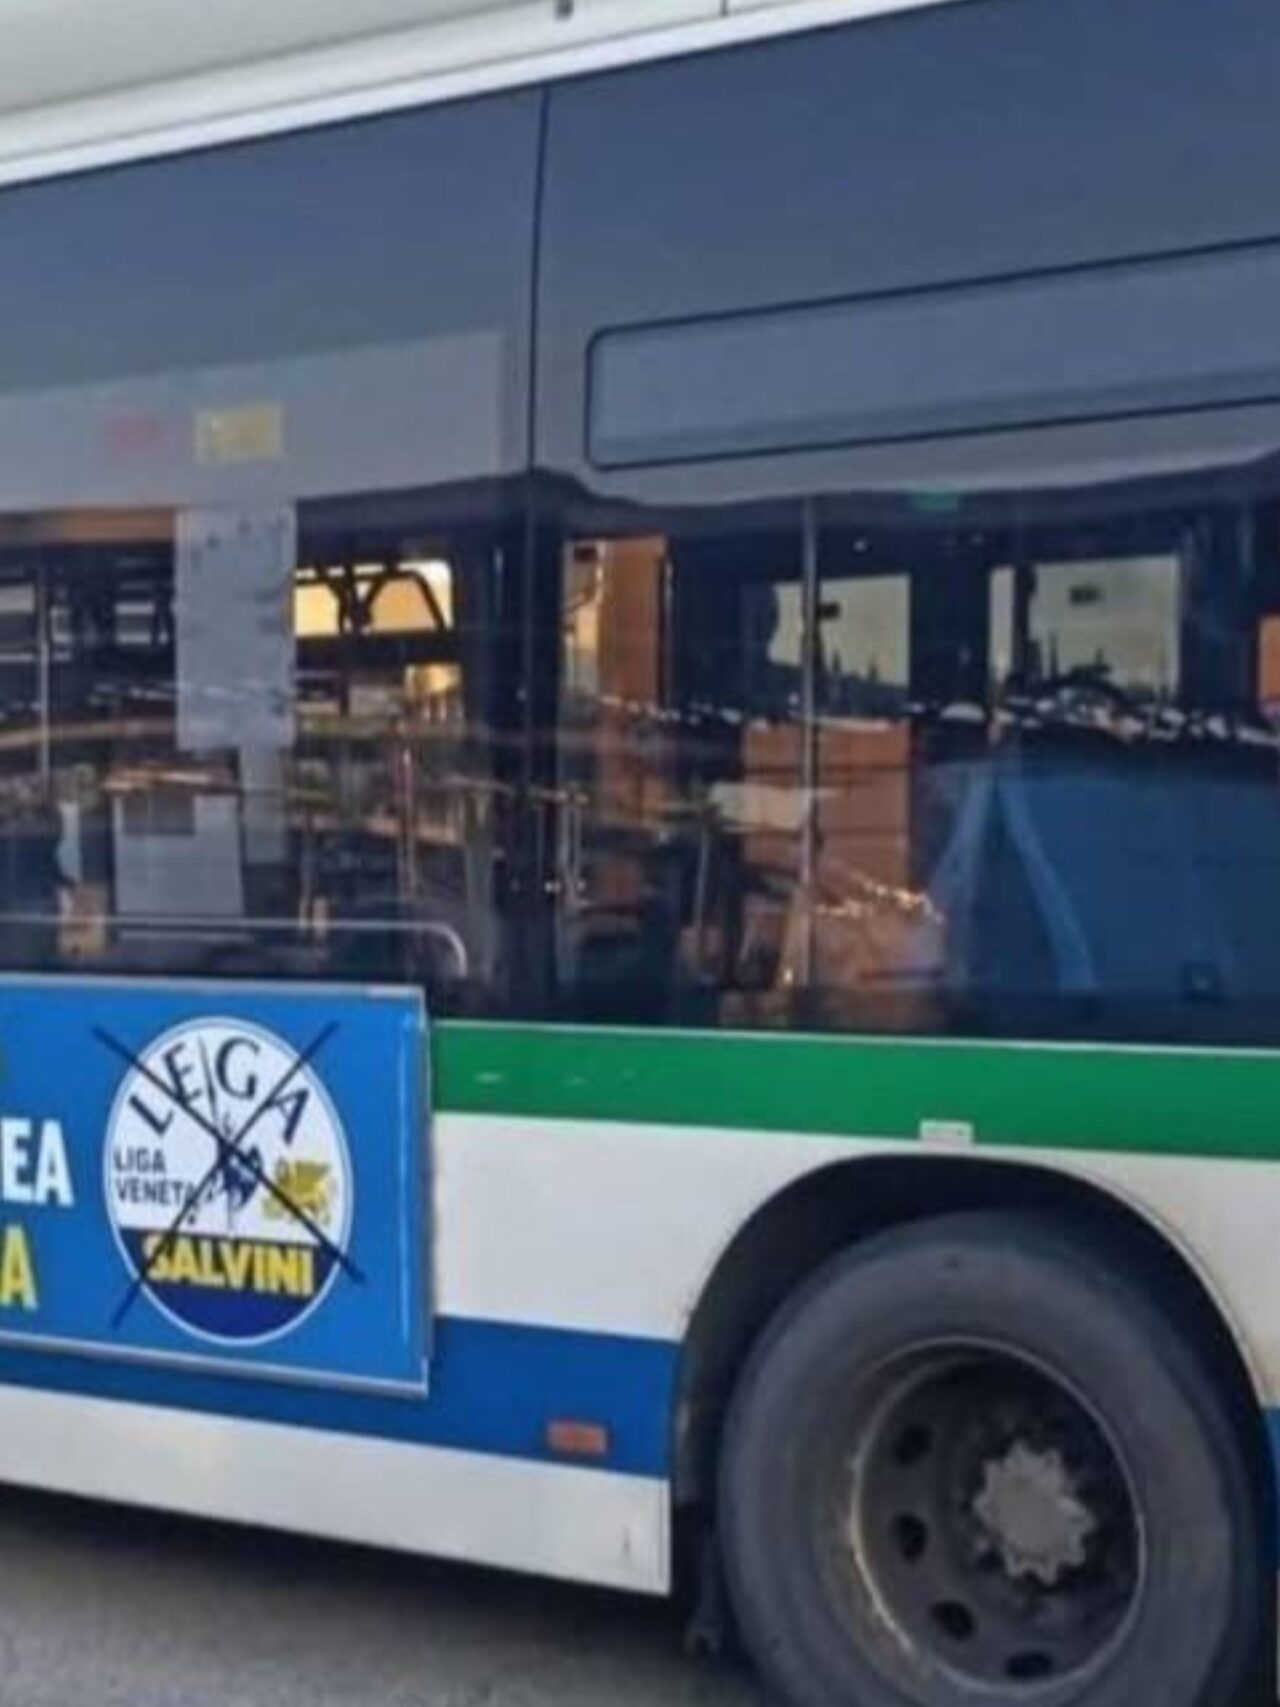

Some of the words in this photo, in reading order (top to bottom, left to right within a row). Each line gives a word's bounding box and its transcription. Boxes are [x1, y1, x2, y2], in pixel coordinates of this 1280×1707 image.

[128, 1036, 310, 1145] LEGA
[113, 1146, 167, 1174] LIGA
[142, 1234, 314, 1298] SALVINI
